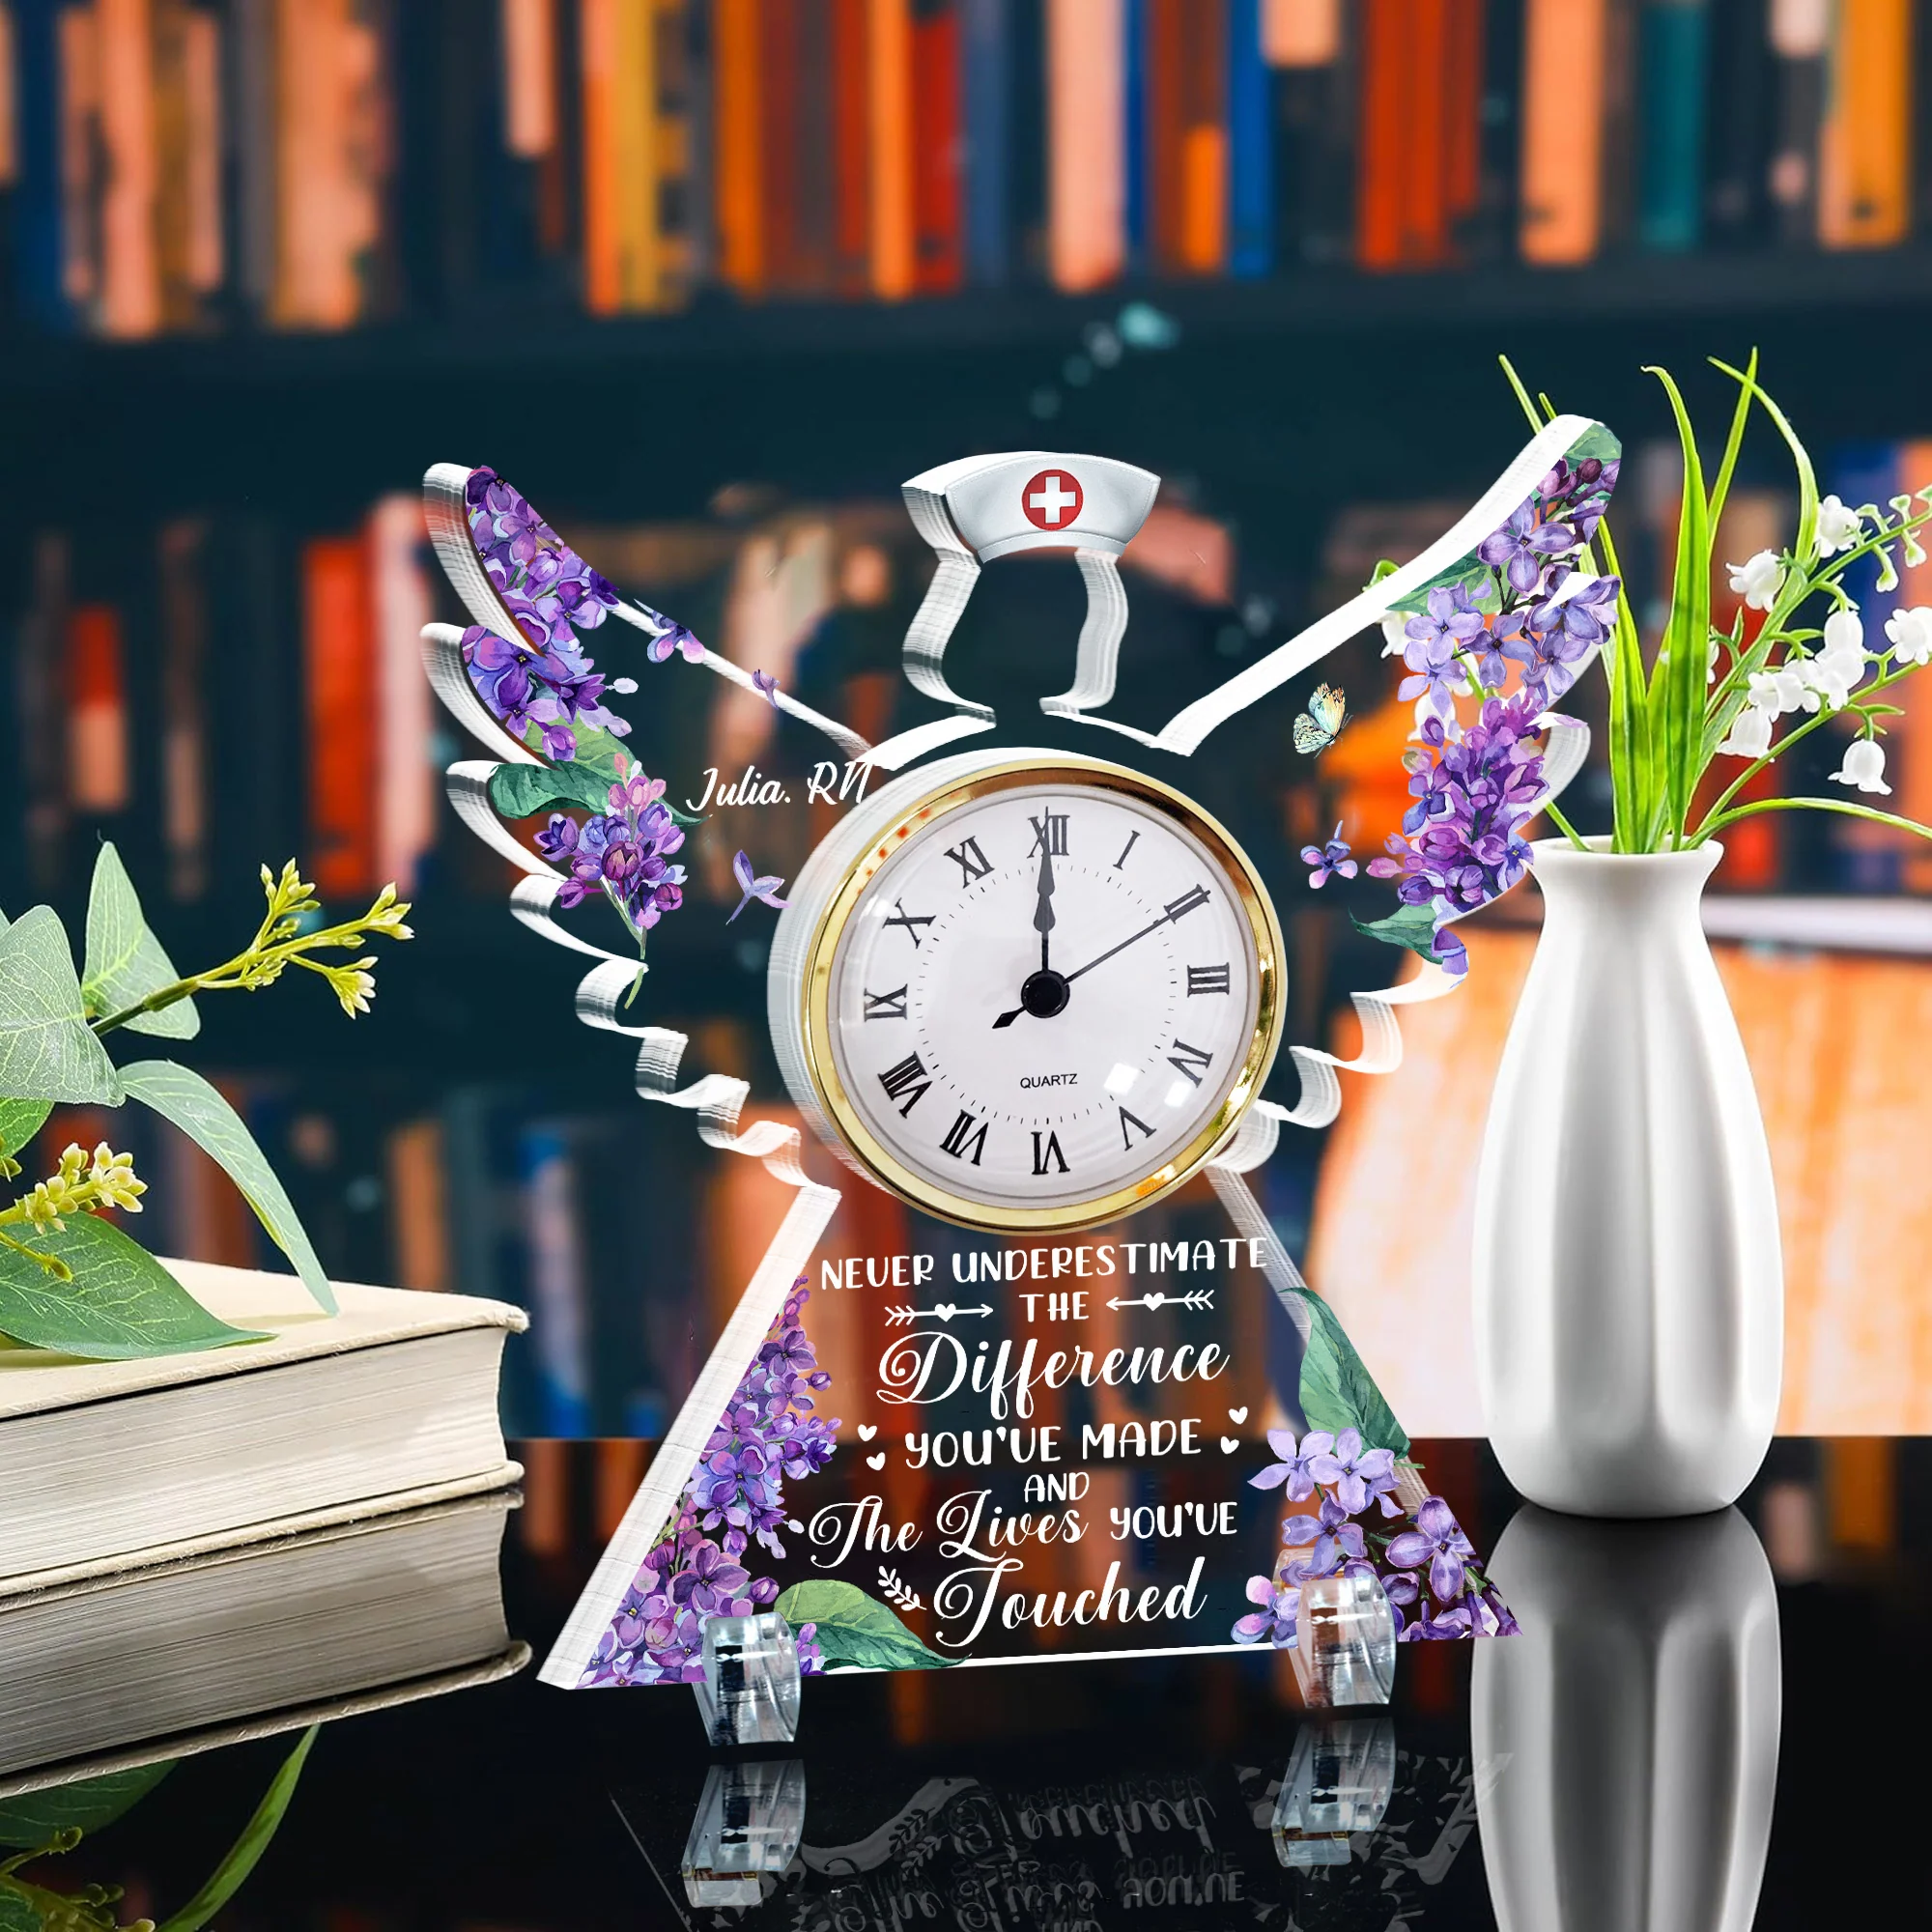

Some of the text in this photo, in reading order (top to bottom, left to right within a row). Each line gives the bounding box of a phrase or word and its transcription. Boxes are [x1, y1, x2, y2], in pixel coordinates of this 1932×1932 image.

[686, 760, 874, 811] Julia. RN
[1027, 814, 1070, 858] XII
[1113, 830, 1141, 870] I
[944, 836, 995, 889] XI
[882, 897, 937, 949] X
[1163, 884, 1211, 924] II
[864, 983, 908, 1022] IX
[1186, 962, 1230, 998] III
[877, 1051, 933, 1119] VIII
[1019, 1073, 1078, 1089] QUARTZ
[1167, 1038, 1214, 1088] IV
[939, 1109, 990, 1166] VII
[1031, 1129, 1071, 1175] VI
[1118, 1106, 1157, 1151] V
[821, 1236, 1267, 1291] NEVER UNDERESTIMATE
[1019, 1291, 1090, 1322] THE
[876, 1331, 1230, 1420] Difference
[905, 1418, 1202, 1469] YOU'VE MADE
[1024, 1472, 1090, 1502] AND
[808, 1489, 1238, 1569] The Lives YOU'VE
[933, 1556, 1208, 1647] Touched
